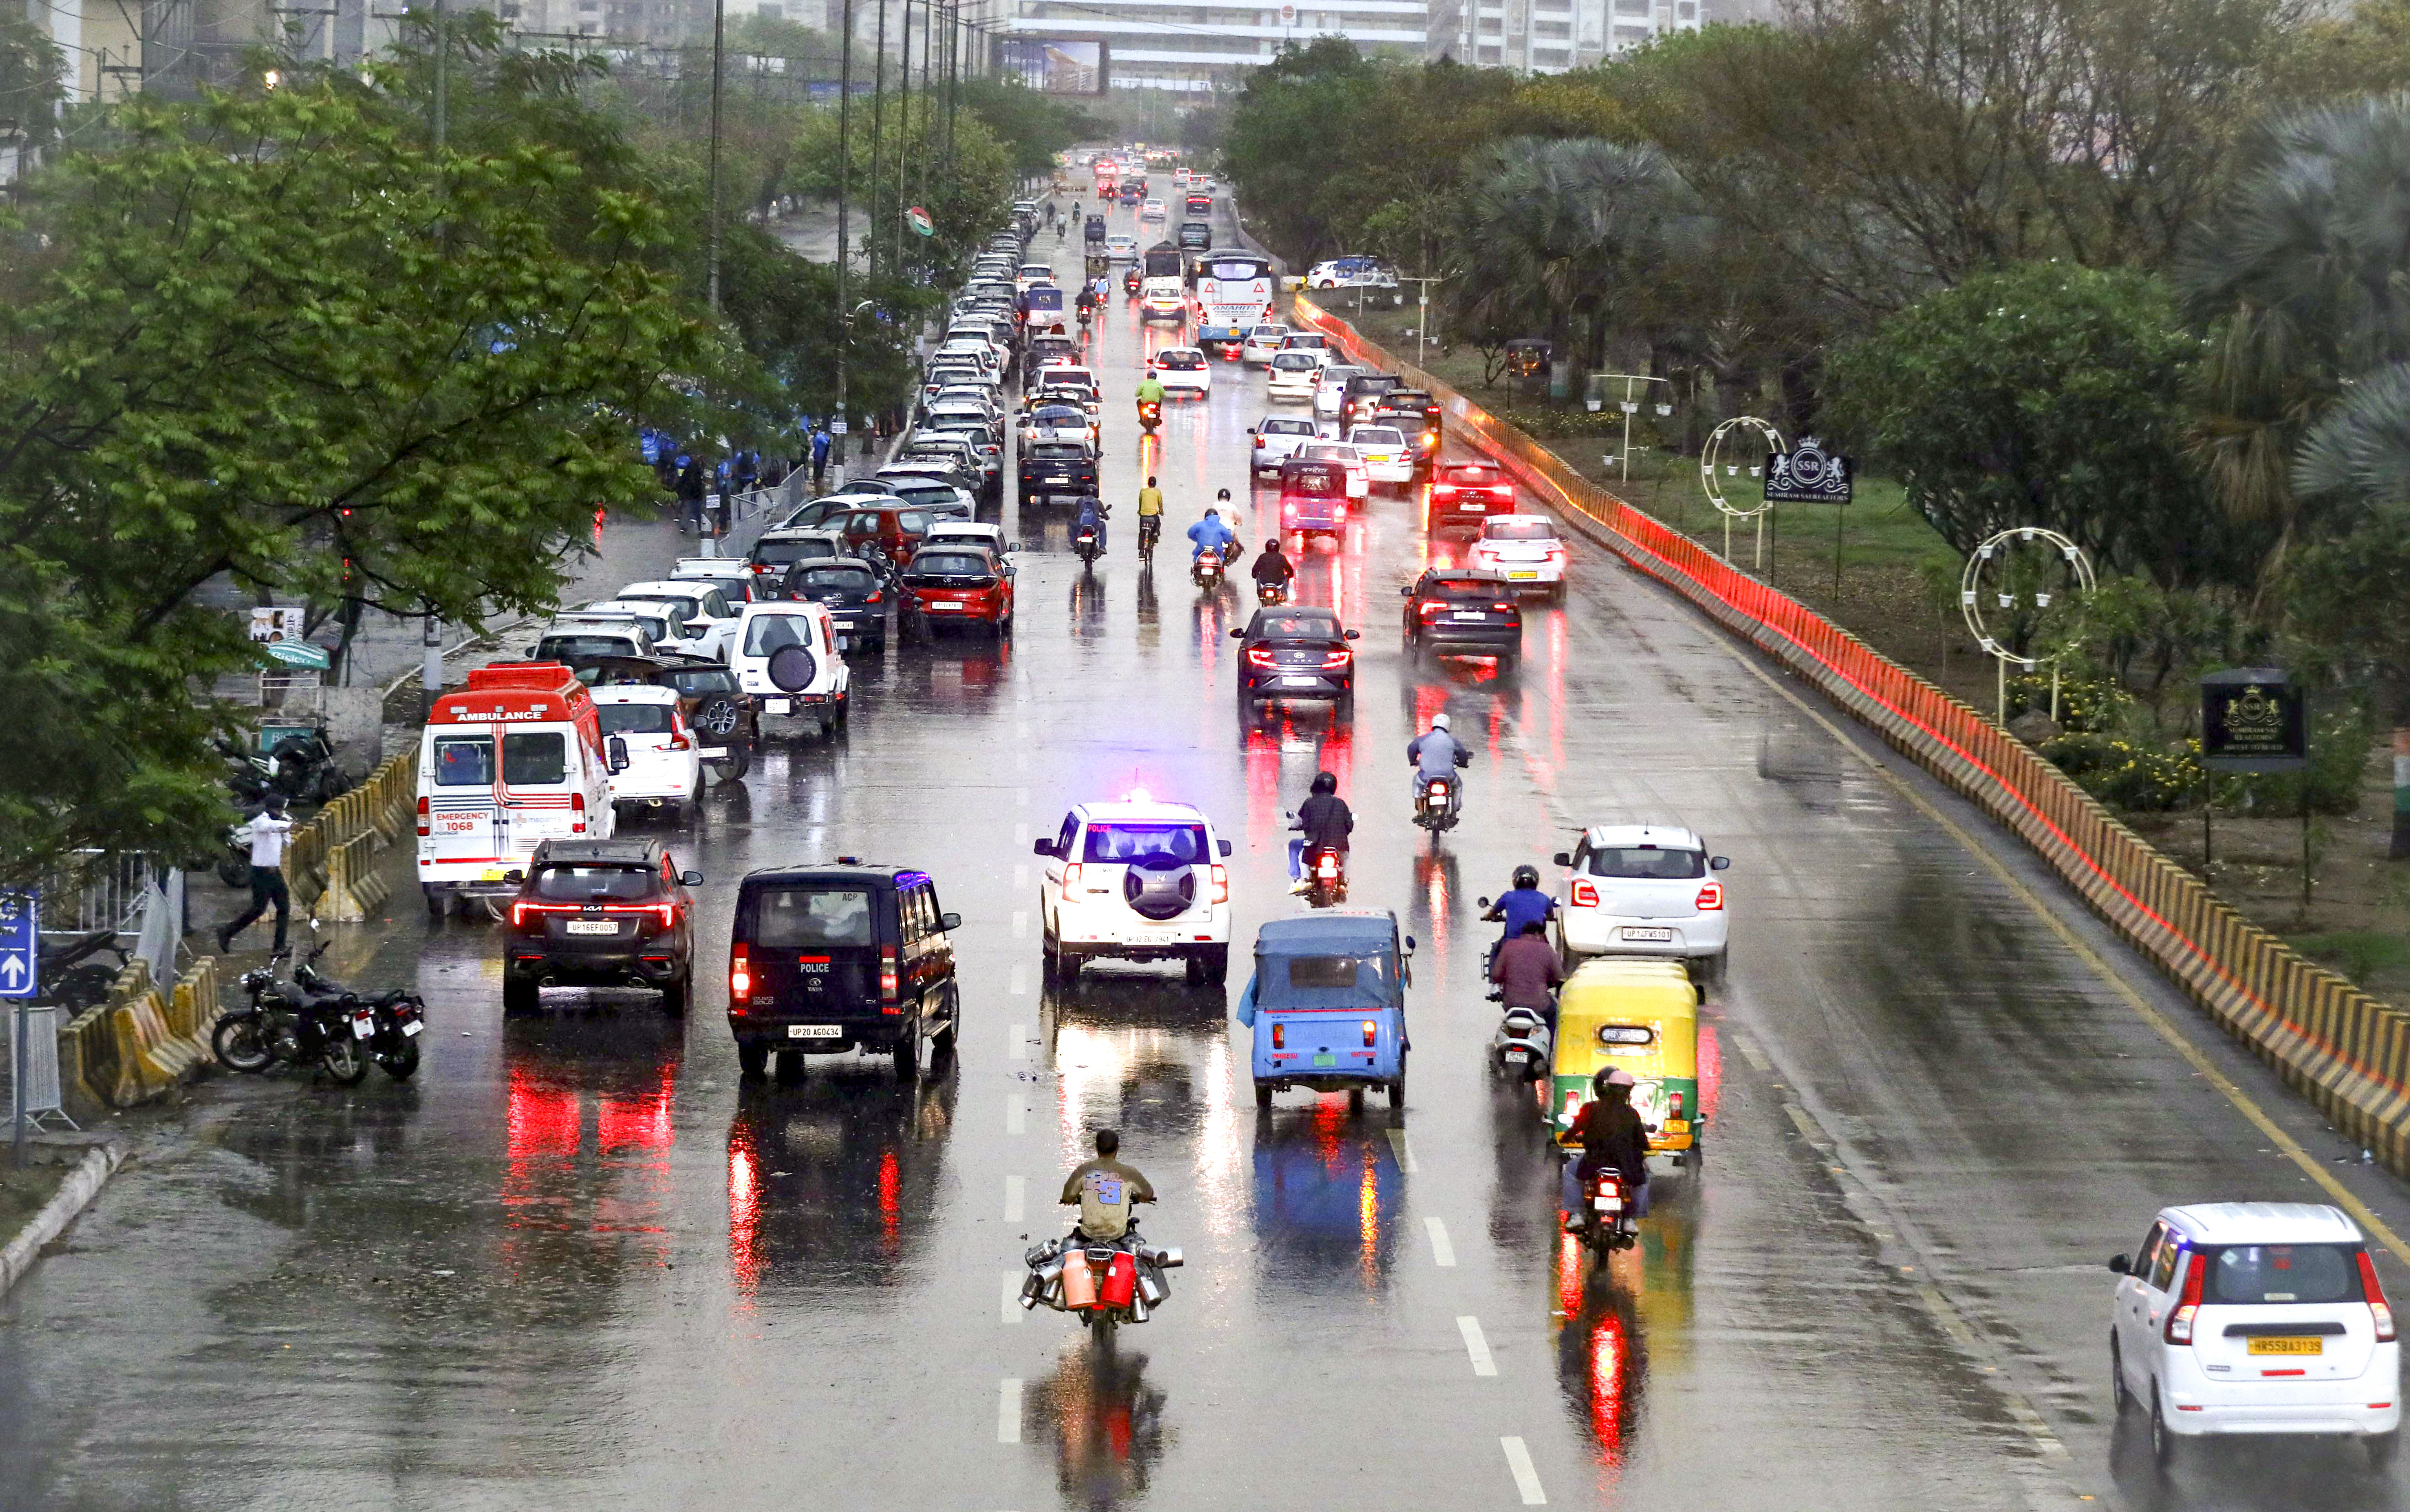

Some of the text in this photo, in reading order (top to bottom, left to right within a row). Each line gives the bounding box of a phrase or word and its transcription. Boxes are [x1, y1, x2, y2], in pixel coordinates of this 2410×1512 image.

[1797, 461, 1819, 471] SSR
[457, 712, 542, 721] AMBULANCE
[437, 812, 489, 820] EMERGENCY
[446, 822, 473, 831] 1068
[842, 893, 858, 902] ACP
[800, 963, 829, 973] POLICE
